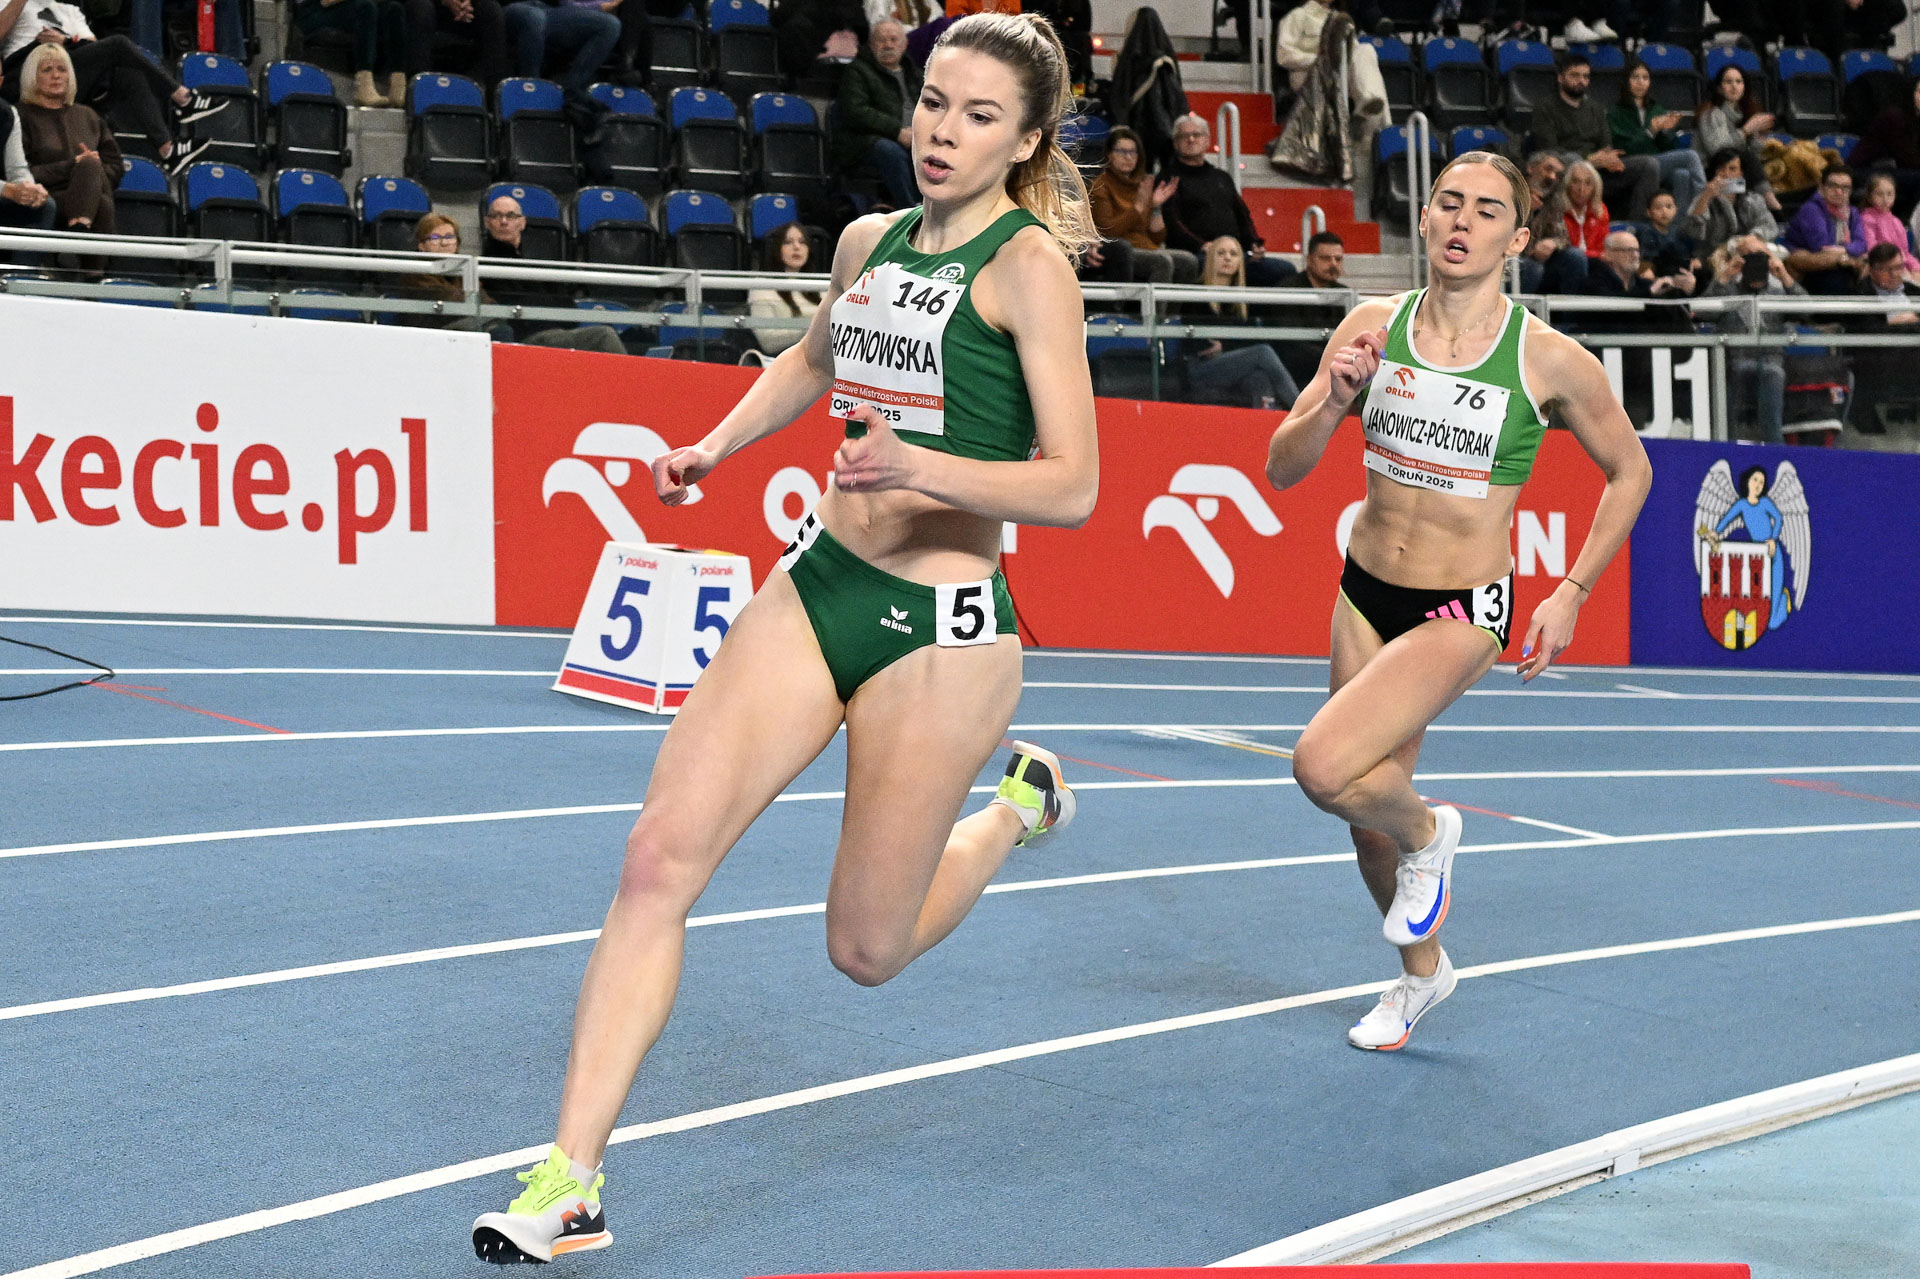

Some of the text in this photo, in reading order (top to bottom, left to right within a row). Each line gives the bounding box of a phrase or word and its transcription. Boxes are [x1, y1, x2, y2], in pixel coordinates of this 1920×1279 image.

[846, 293, 870, 306] ORLEN
[892, 281, 950, 315] 146
[860, 387, 908, 403] Mistrzostwa
[910, 396, 938, 407] Polski
[1385, 386, 1415, 400] ORLEN
[1453, 383, 1486, 410] 76
[1367, 407, 1493, 457] JANOWICZ-PÓŁTORAK
[1378, 447, 1392, 459] PZLA
[1392, 453, 1417, 467] Halowe
[1417, 461, 1461, 477] Mistrzostwa
[1462, 469, 1486, 480] Polski
[1387, 464, 1454, 489] TORUŃ 2025
[0, 396, 428, 565] kecie.pl
[624, 556, 658, 571] polanik
[700, 565, 734, 576] polanik
[950, 586, 985, 641] 5
[1484, 583, 1504, 622] 3
[600, 576, 650, 661] 5
[693, 586, 730, 669] 5
[879, 616, 913, 634] erima
